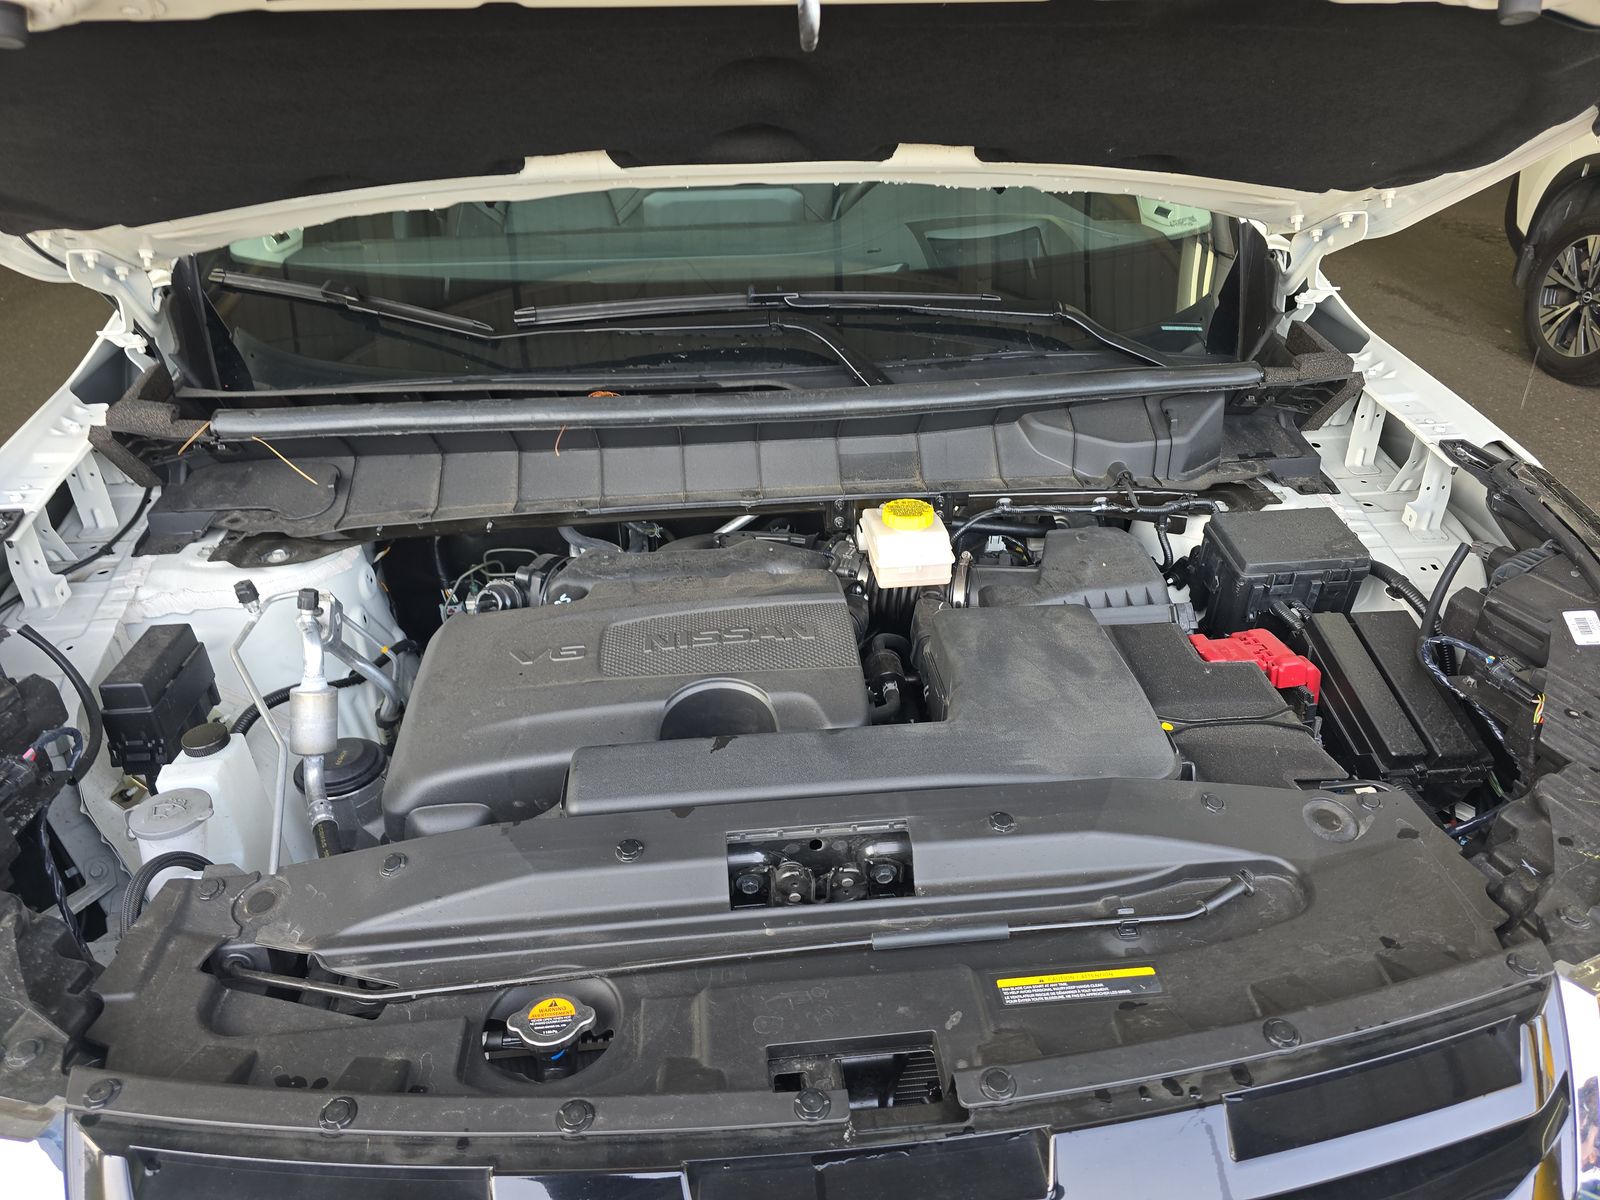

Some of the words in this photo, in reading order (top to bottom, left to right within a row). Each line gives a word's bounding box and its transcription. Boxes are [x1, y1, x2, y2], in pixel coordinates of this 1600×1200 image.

[644, 621, 816, 653] NISSAN
[509, 645, 586, 665] V6
[1047, 974, 1075, 982] CAUTION
